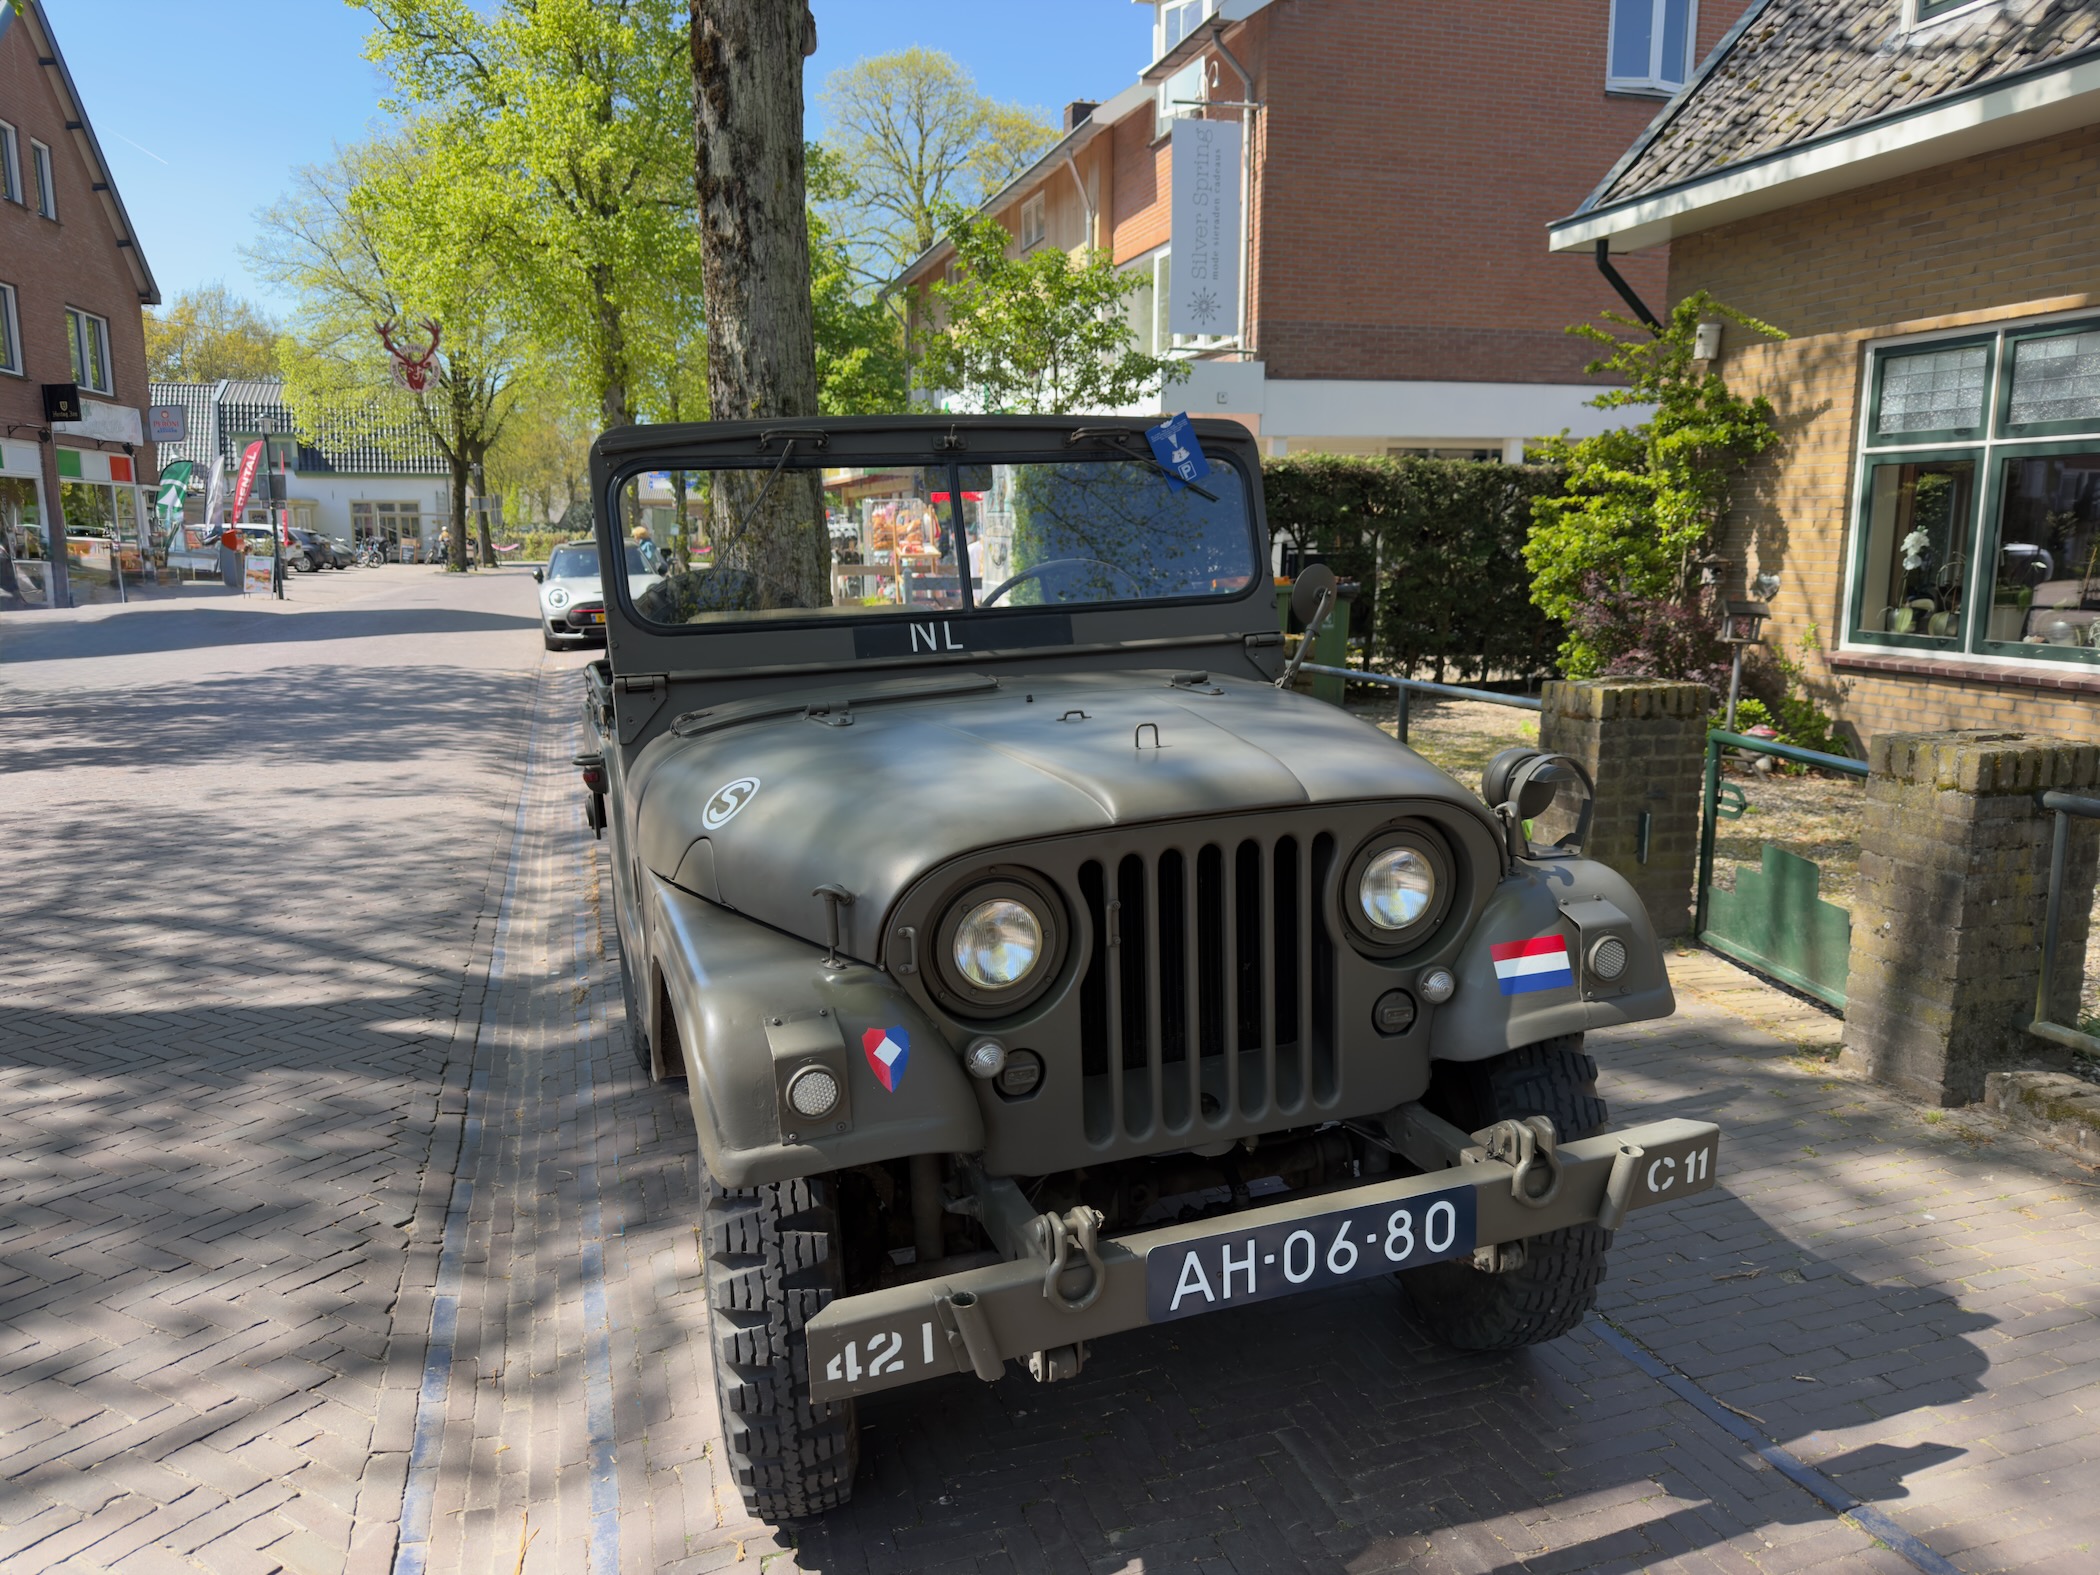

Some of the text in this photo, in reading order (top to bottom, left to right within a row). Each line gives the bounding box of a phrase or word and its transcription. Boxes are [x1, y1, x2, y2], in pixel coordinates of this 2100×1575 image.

[1191, 127, 1213, 280] Silver Spring
[1212, 198, 1220, 246] sieraden
[1211, 251, 1219, 280] mode
[1181, 464, 1191, 479] P
[910, 620, 964, 652] NL
